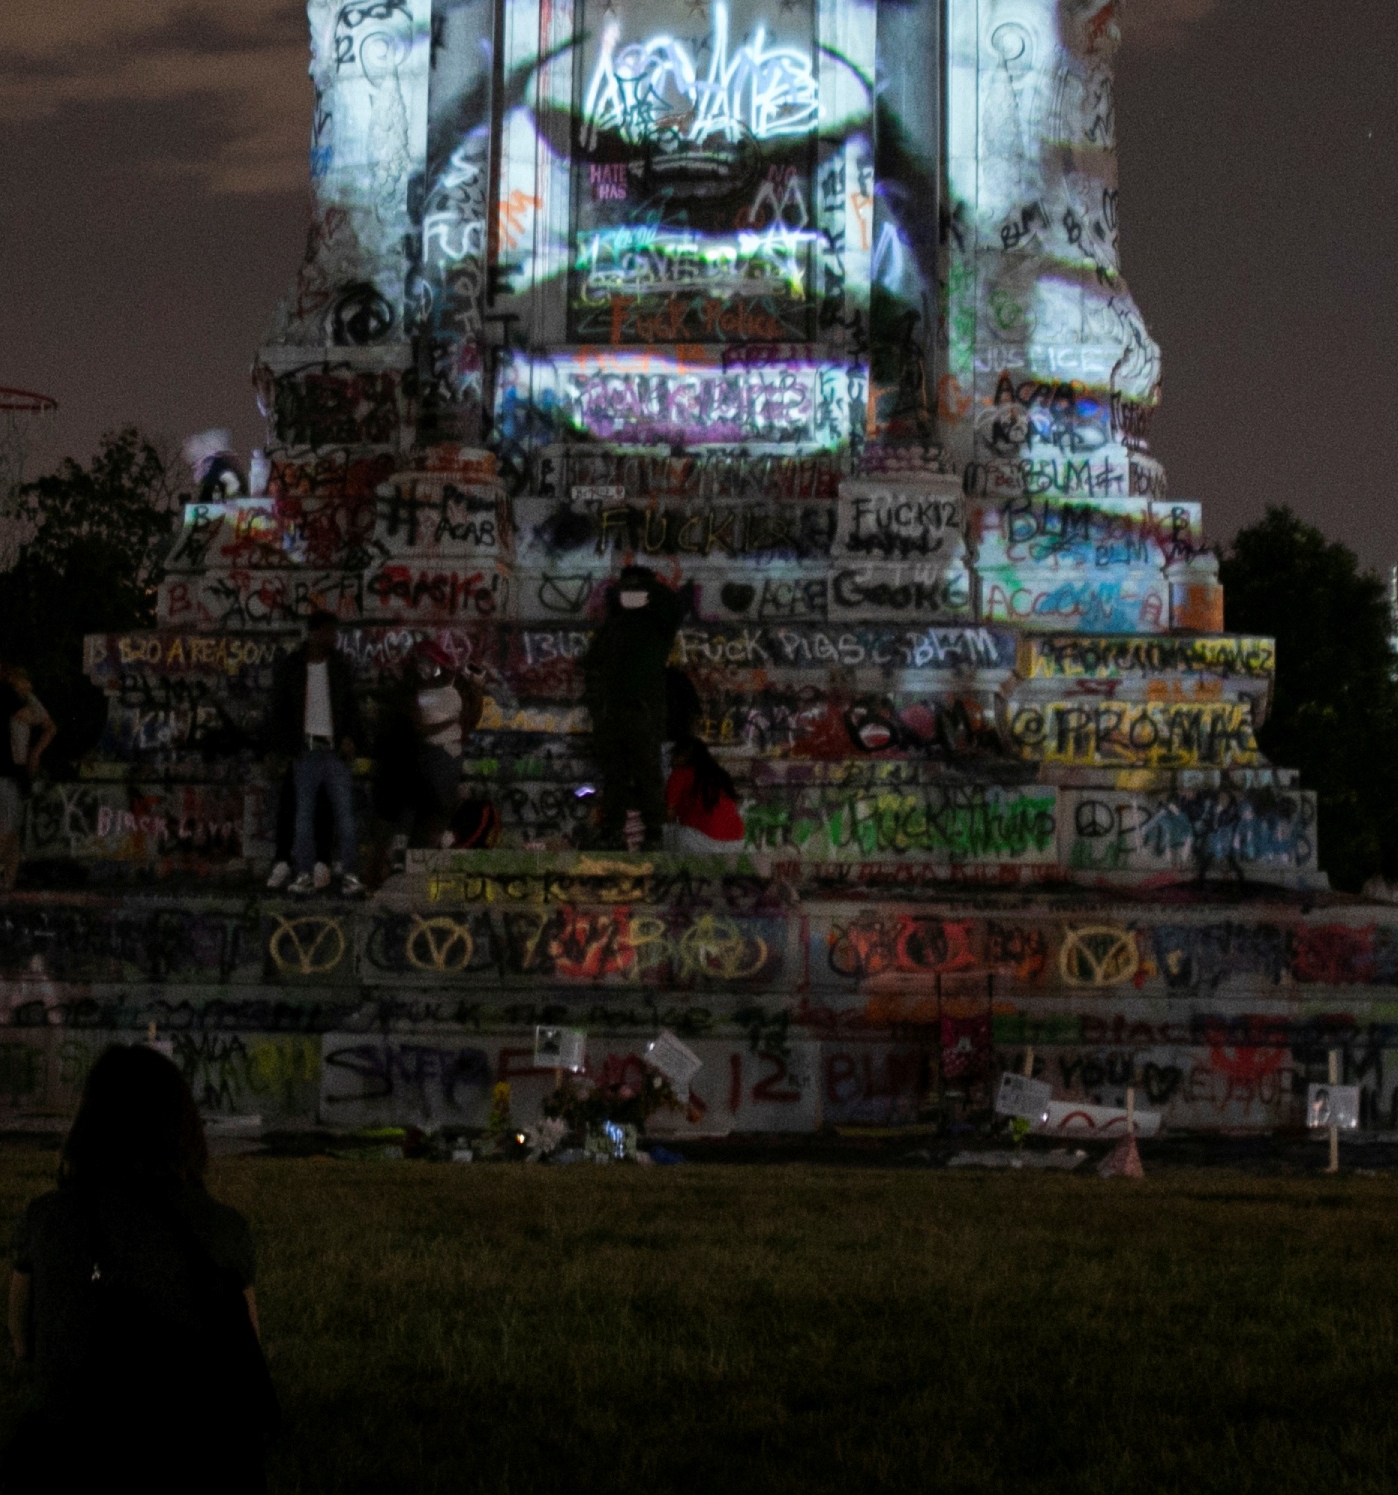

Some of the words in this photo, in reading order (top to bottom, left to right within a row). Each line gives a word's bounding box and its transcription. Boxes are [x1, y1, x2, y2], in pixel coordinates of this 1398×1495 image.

[435, 520, 496, 547] ACAB
[601, 506, 737, 552] FUCK
[166, 638, 186, 664] A
[190, 637, 276, 665] REASON
